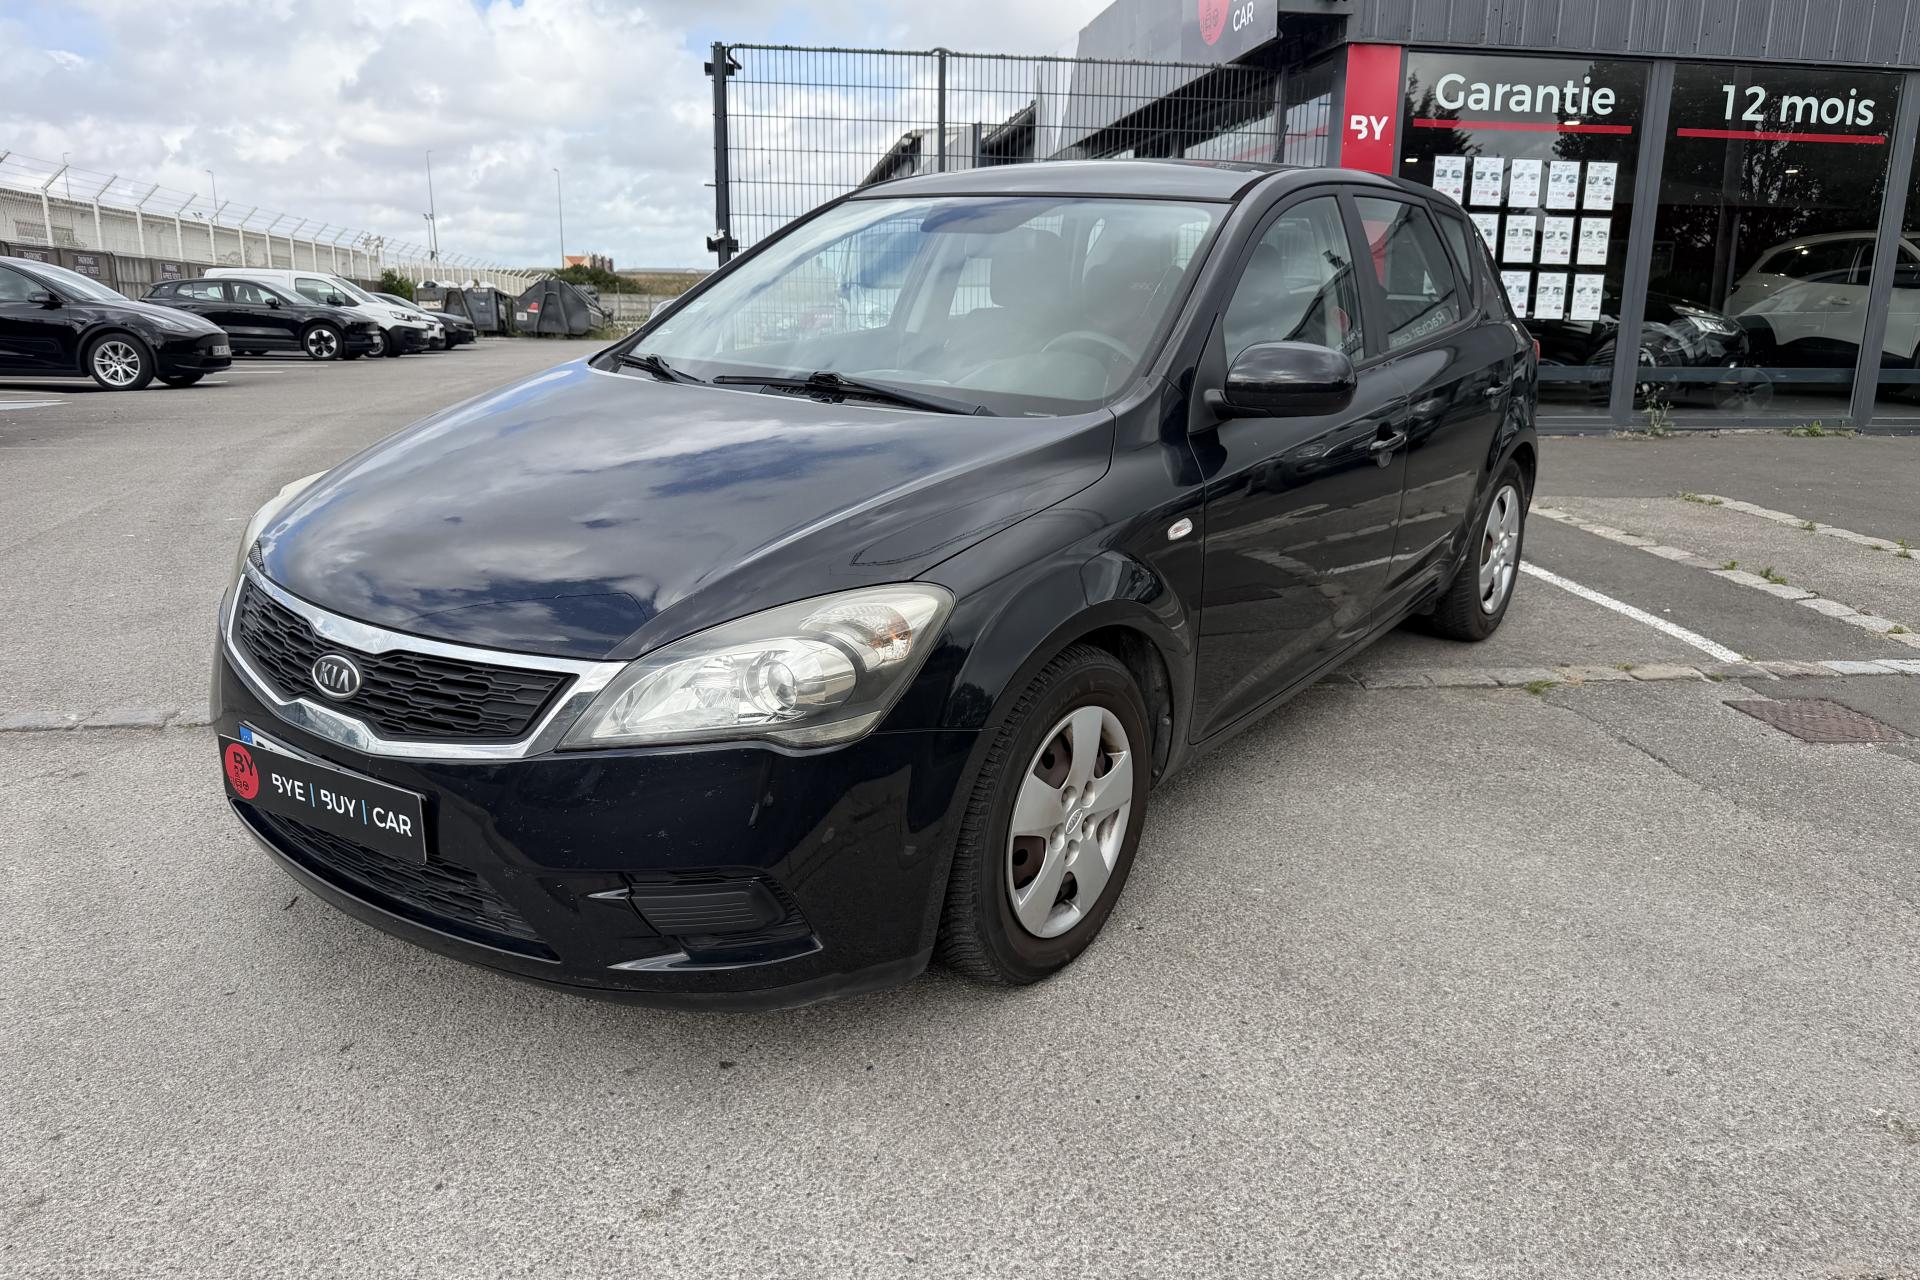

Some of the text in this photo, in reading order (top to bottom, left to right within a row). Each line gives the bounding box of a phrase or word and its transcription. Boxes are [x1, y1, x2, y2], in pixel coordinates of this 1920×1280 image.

[1233, 1, 1254, 32] CAR
[1435, 73, 1616, 115] Garantie
[1722, 84, 1876, 126] 12 mois
[1350, 114, 1389, 140] BY
[319, 661, 349, 691] KIA
[232, 751, 254, 776] BY
[271, 773, 412, 837] BYE BUY CAR
